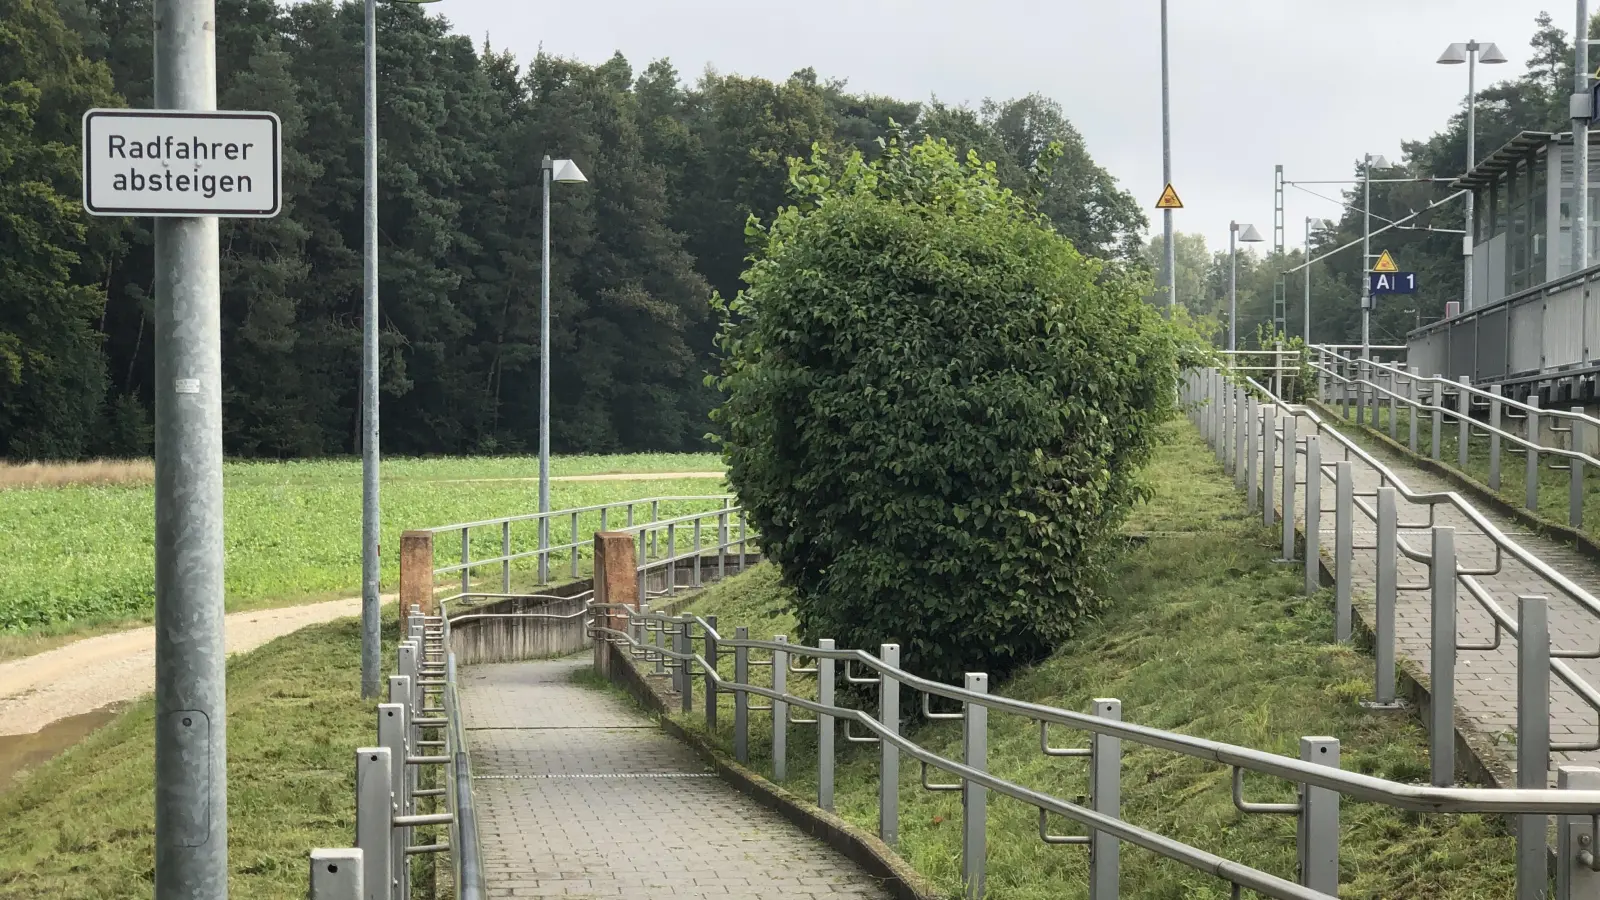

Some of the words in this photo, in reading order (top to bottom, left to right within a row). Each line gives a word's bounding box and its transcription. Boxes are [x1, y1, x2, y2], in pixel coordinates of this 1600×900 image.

[108, 134, 254, 160] Radfahrer
[112, 167, 252, 199] absteigen
[1376, 274, 1390, 290] A
[1406, 273, 1414, 289] 1
